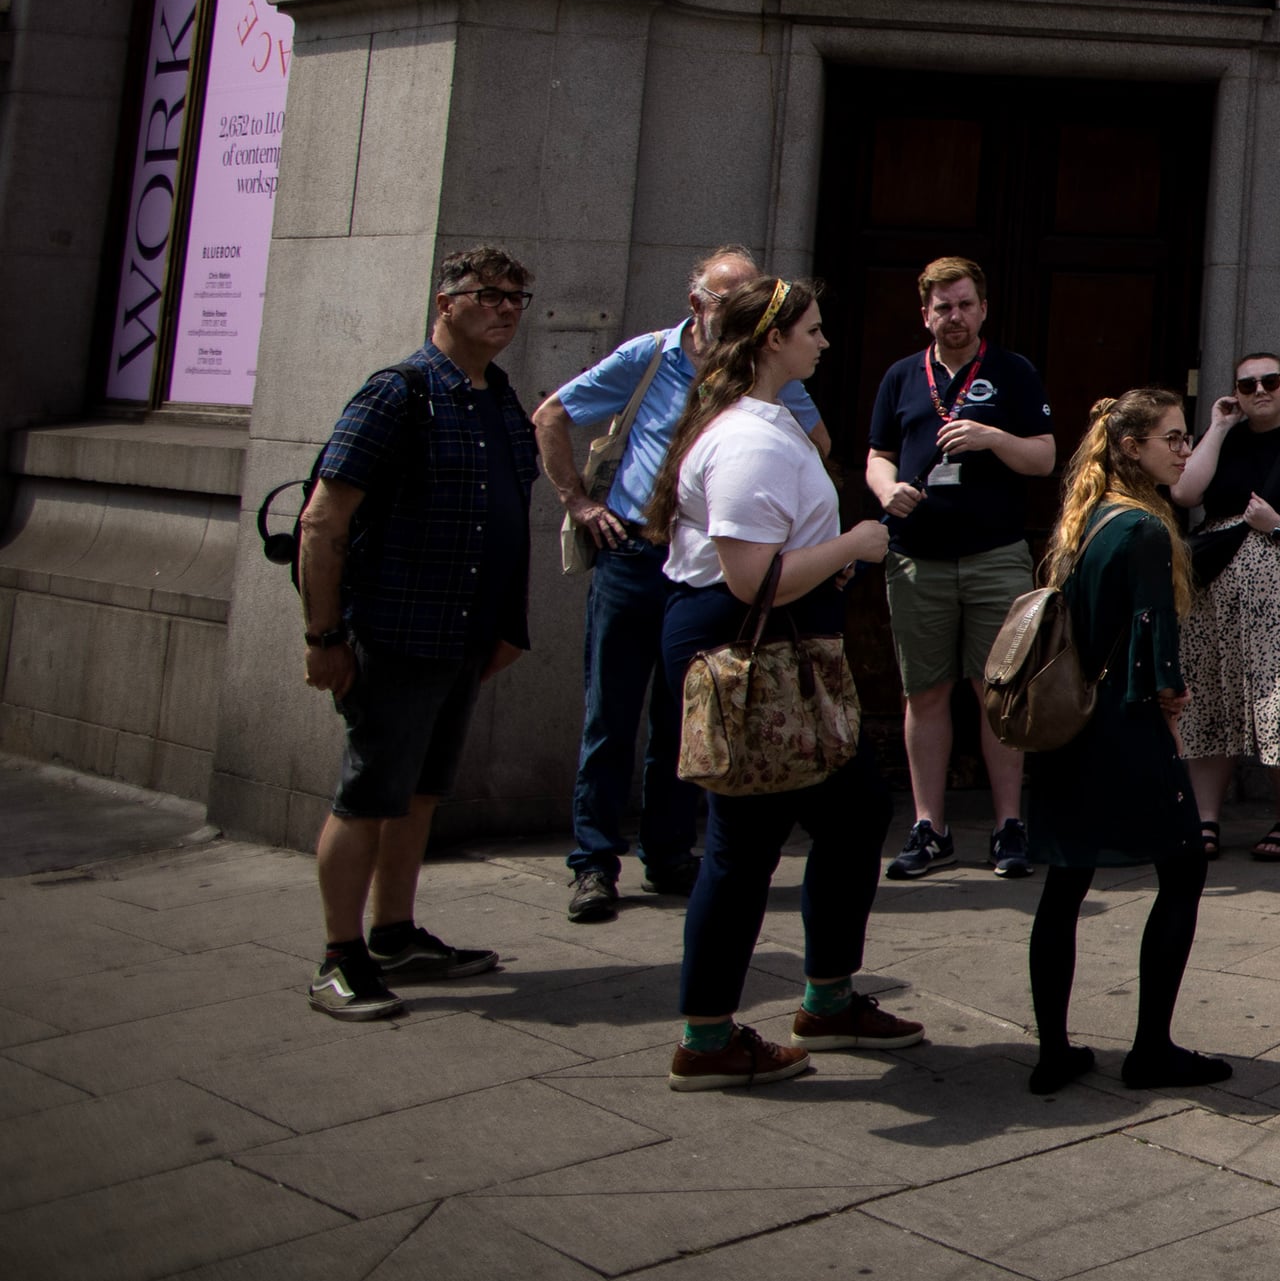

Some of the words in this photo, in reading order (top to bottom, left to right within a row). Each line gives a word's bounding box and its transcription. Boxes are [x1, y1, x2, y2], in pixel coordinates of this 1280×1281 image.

[219, 114, 249, 140] 2,652
[251, 119, 263, 136] to
[222, 143, 236, 167] of
[117, 4, 197, 374] WORK
[202, 246, 241, 259] BLUEBOOK
